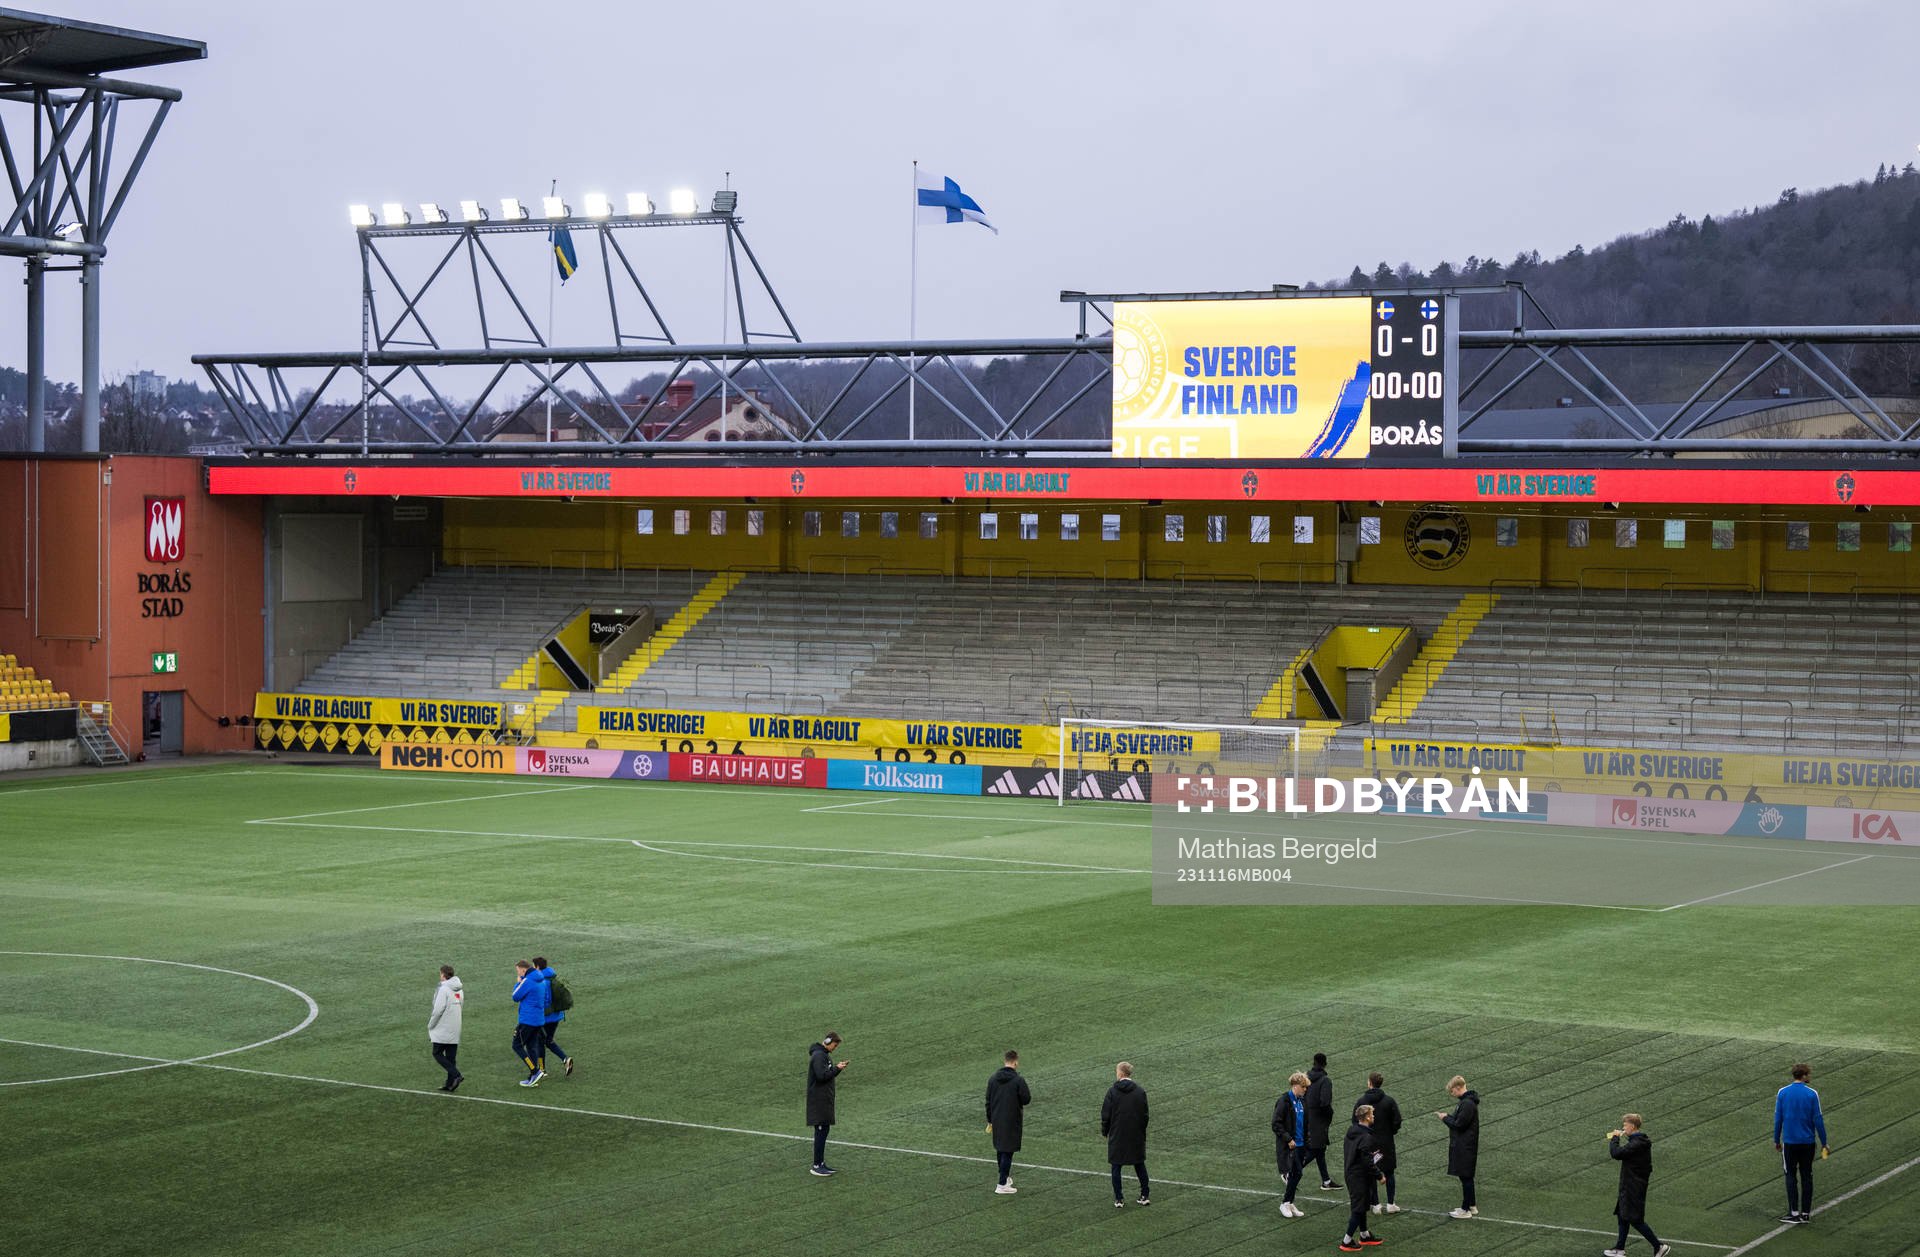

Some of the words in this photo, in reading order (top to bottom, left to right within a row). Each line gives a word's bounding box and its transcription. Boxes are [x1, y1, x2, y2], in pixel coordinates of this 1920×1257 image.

[1378, 325, 1392, 357] 0
[1422, 324, 1437, 356] 0
[1184, 346, 1296, 377] SVERIGE
[1182, 384, 1297, 415] FINLAND
[1371, 419, 1443, 446] BORÅS
[521, 471, 535, 490] VI
[557, 472, 611, 491] SVERIGE
[964, 472, 979, 491] VI
[1477, 474, 1494, 495] VI
[1524, 474, 1596, 496] SVERIGE
[137, 567, 192, 594] BORÅS
[142, 597, 184, 619] STAD
[276, 697, 290, 714] VI
[292, 698, 311, 717] ÄR
[401, 702, 415, 721] VI
[417, 703, 438, 722] ÄR
[440, 705, 498, 726] SVERIGE
[599, 711, 634, 731] HEJA
[638, 713, 705, 735] SVERIGE!
[749, 717, 764, 737] VI
[768, 716, 789, 739] ÄR
[793, 719, 861, 742] BLÅGULT
[906, 724, 922, 745] VI
[926, 723, 949, 746] ÄR
[952, 726, 1022, 750] SVERIGE
[1071, 731, 1115, 753] HEJA
[1116, 732, 1193, 757] SVERIGE!
[549, 755, 590, 765] SVENSKA
[549, 764, 570, 774] SPEL
[692, 758, 803, 781] BAUHAUS
[1391, 743, 1410, 766] VI
[1414, 743, 1440, 767] ÄR
[1444, 746, 1526, 772] BLÅGULT
[1583, 752, 1603, 775] VI
[1608, 752, 1635, 777] ÄR
[1640, 754, 1723, 780] SVERIGE
[864, 764, 944, 789] Folksam
[1783, 760, 1832, 785] HEJA
[1641, 805, 1696, 818] SVENSKA
[1641, 817, 1670, 828] SPEL
[1853, 813, 1902, 841] ICA
